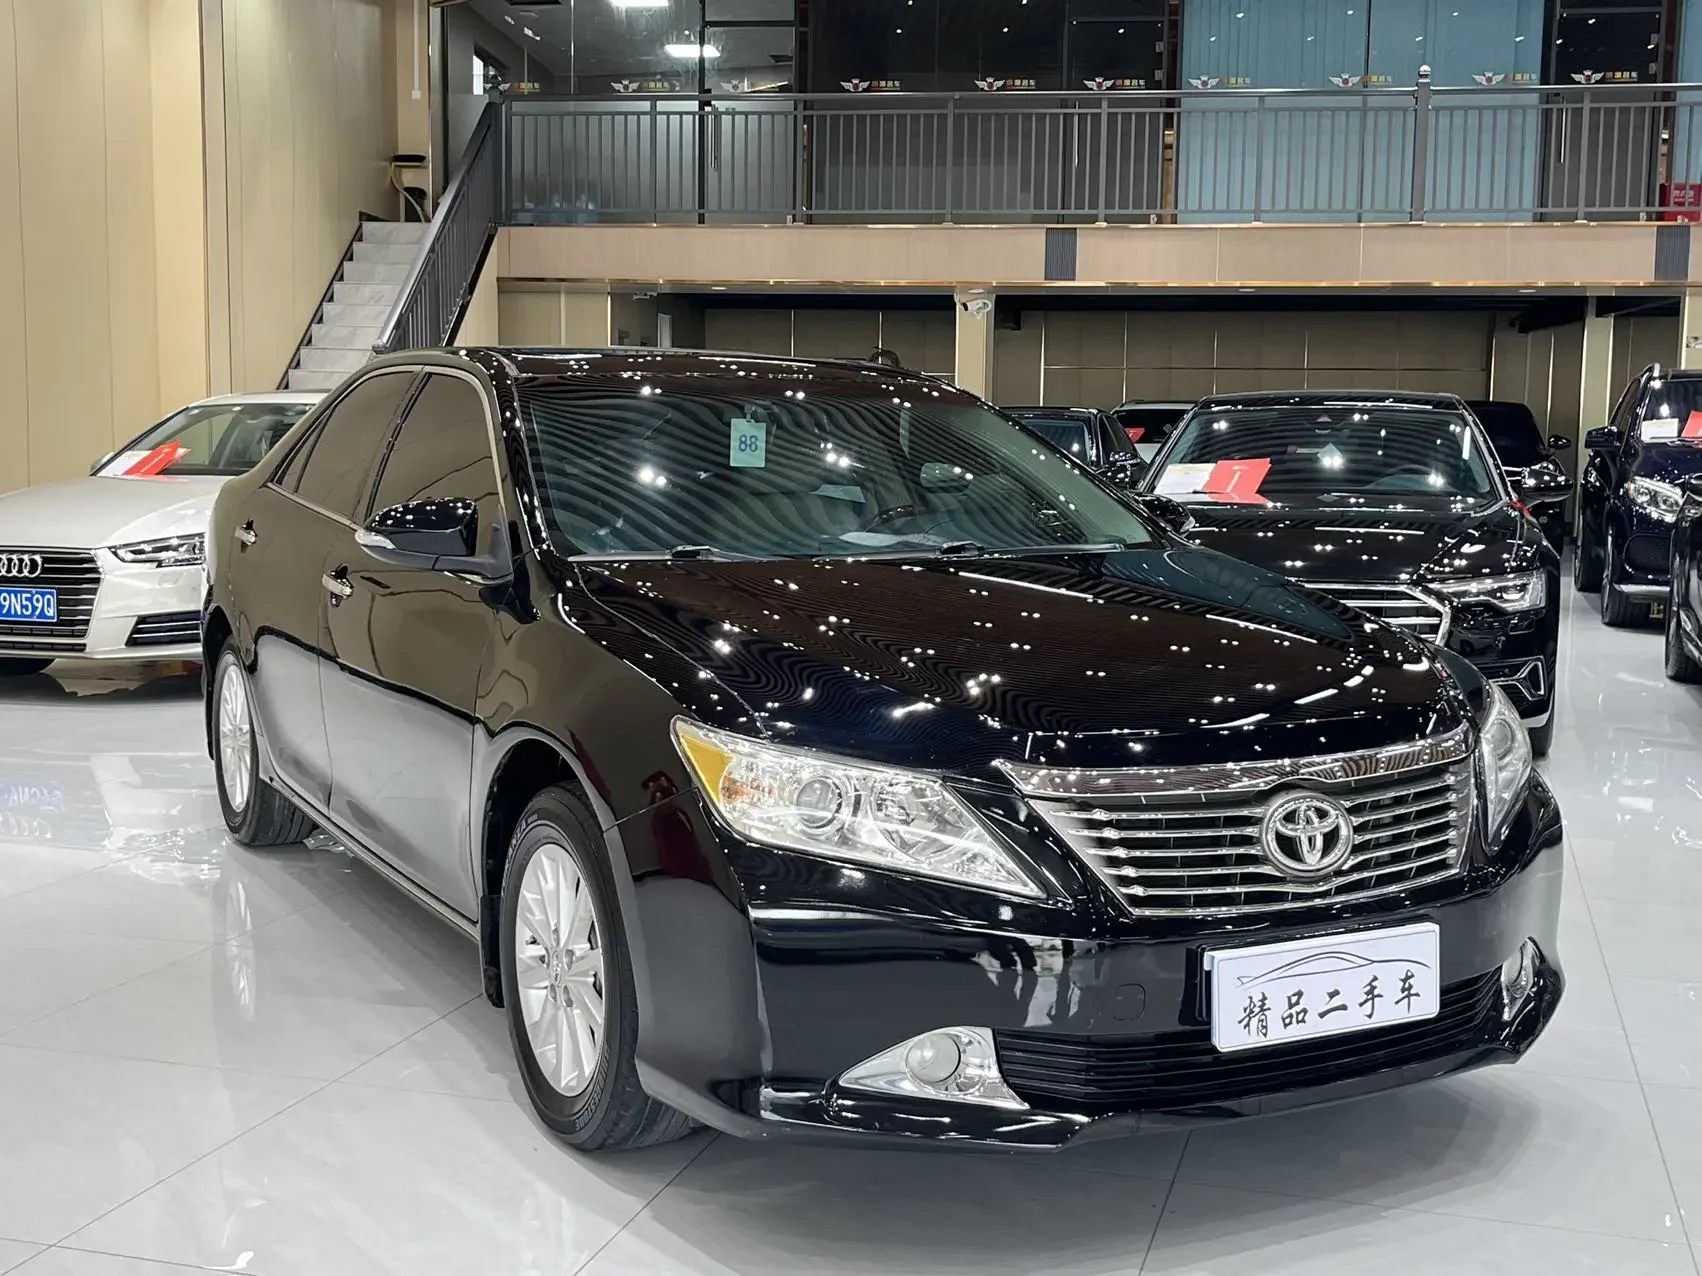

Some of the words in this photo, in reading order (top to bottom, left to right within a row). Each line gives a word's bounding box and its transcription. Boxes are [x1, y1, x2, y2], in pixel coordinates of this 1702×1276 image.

[738, 434, 758, 452] 88
[0, 592, 54, 617] 9N59Q
[1237, 969, 1421, 1039] 精品二手车
